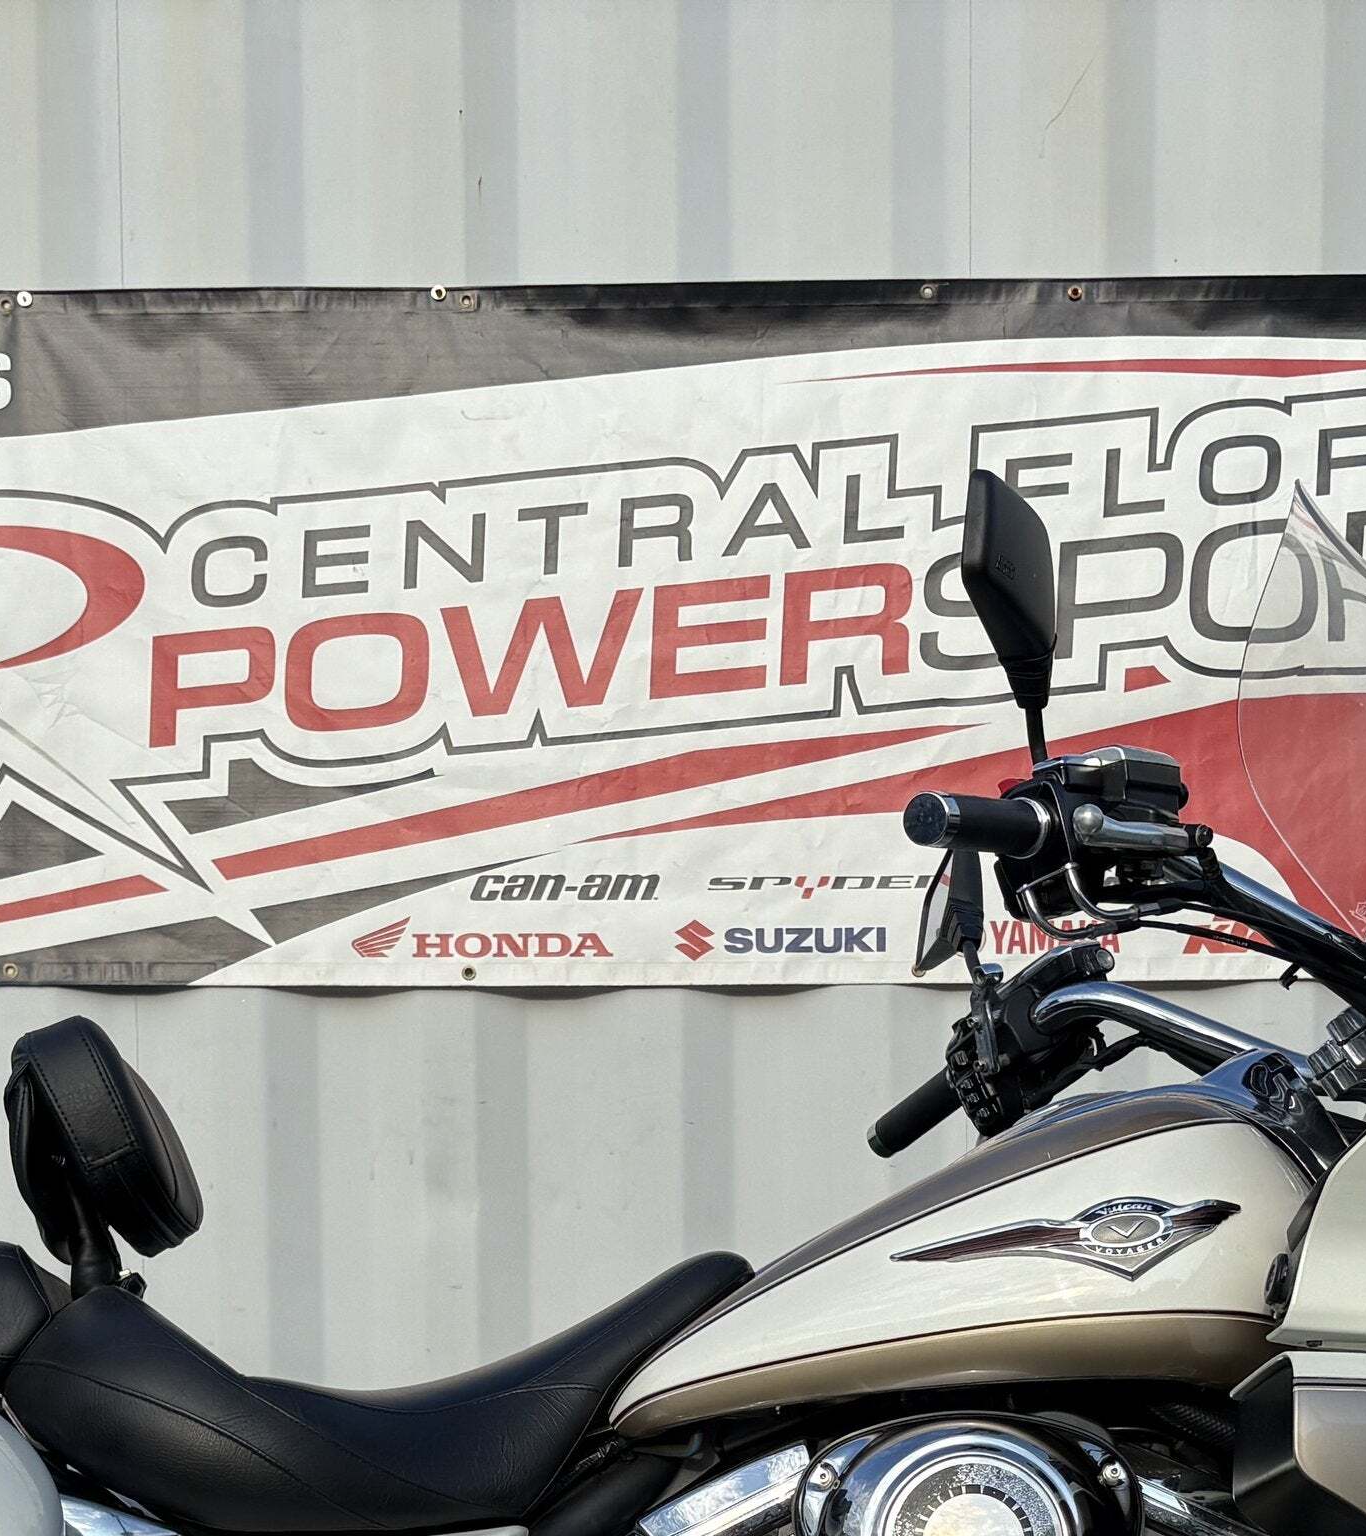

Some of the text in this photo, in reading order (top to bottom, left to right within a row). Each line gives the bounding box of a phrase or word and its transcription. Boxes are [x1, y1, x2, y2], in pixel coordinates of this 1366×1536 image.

[191, 471, 906, 608] CENTRAL
[411, 931, 614, 959] HONDA
[723, 926, 886, 954] SUZUKI
[1095, 1238, 1164, 1255] VOYAGER
